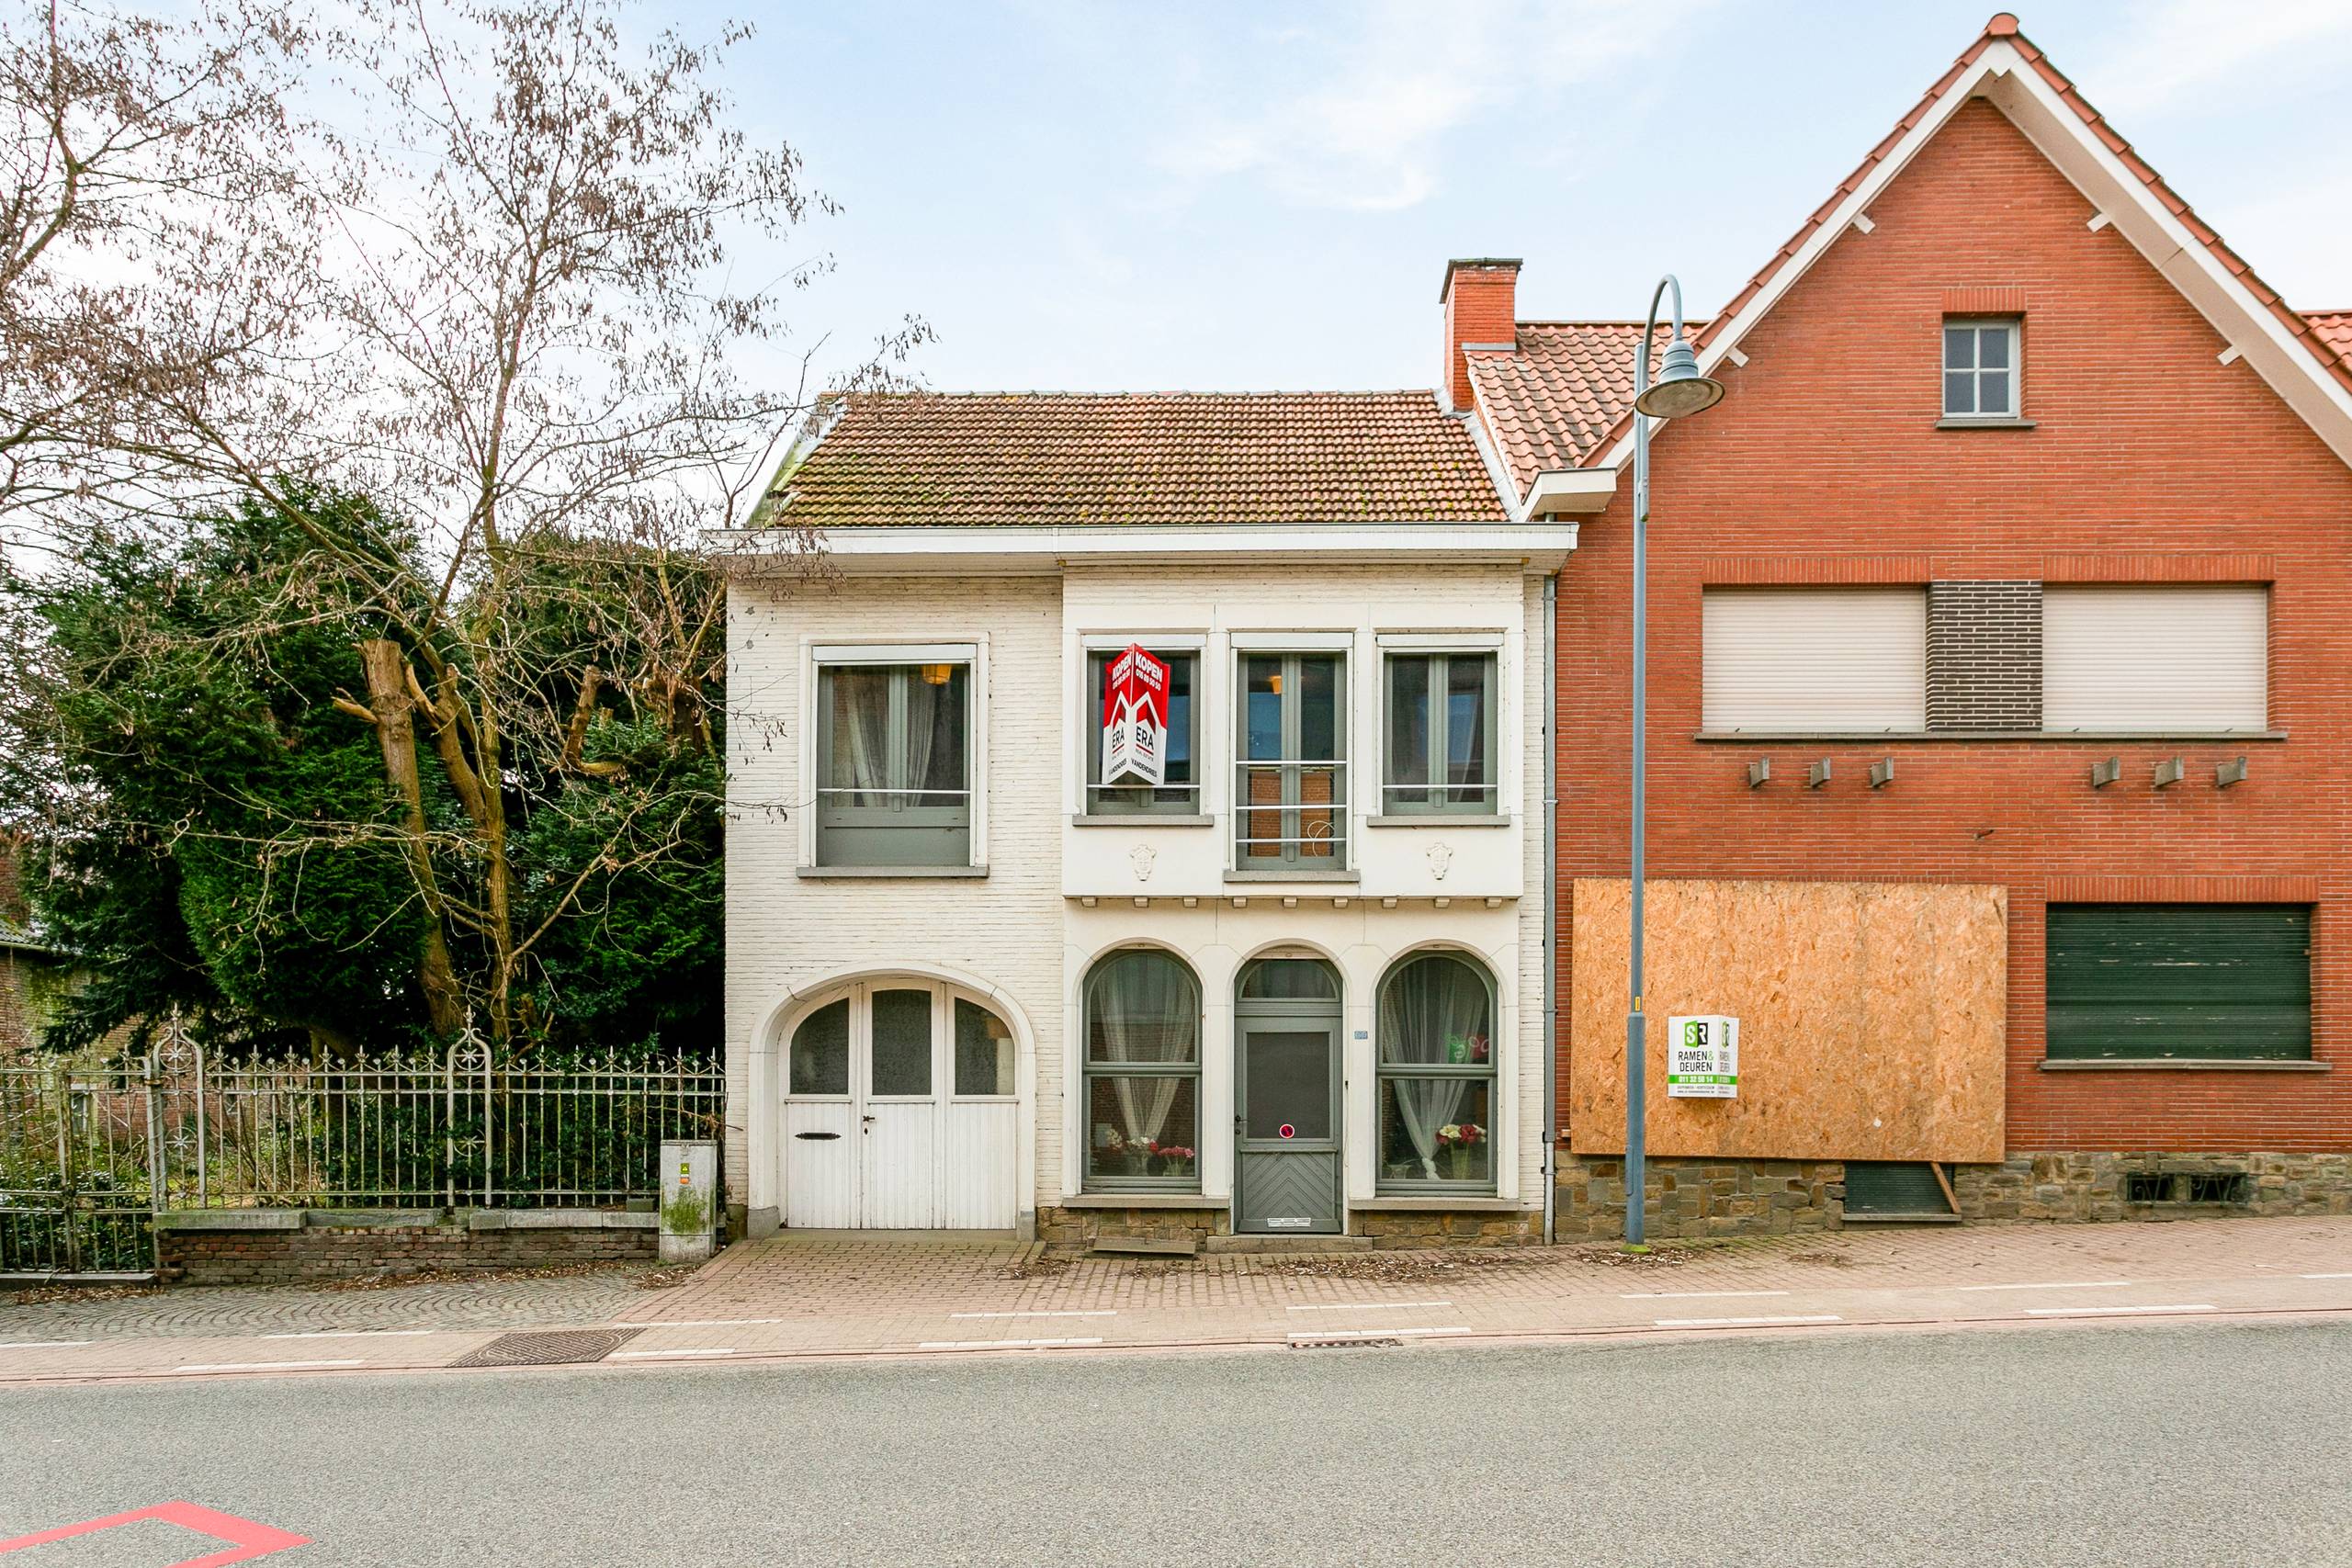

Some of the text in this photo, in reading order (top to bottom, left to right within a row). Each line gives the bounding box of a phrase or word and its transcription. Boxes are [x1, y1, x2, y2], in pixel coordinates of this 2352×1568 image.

[1136, 652, 1162, 682] KOPEN
[1112, 728, 1125, 749] ERA
[1136, 726, 1154, 750] ERA
[1686, 1024, 1706, 1043] SR
[1679, 1062, 1713, 1072] DEUREN
